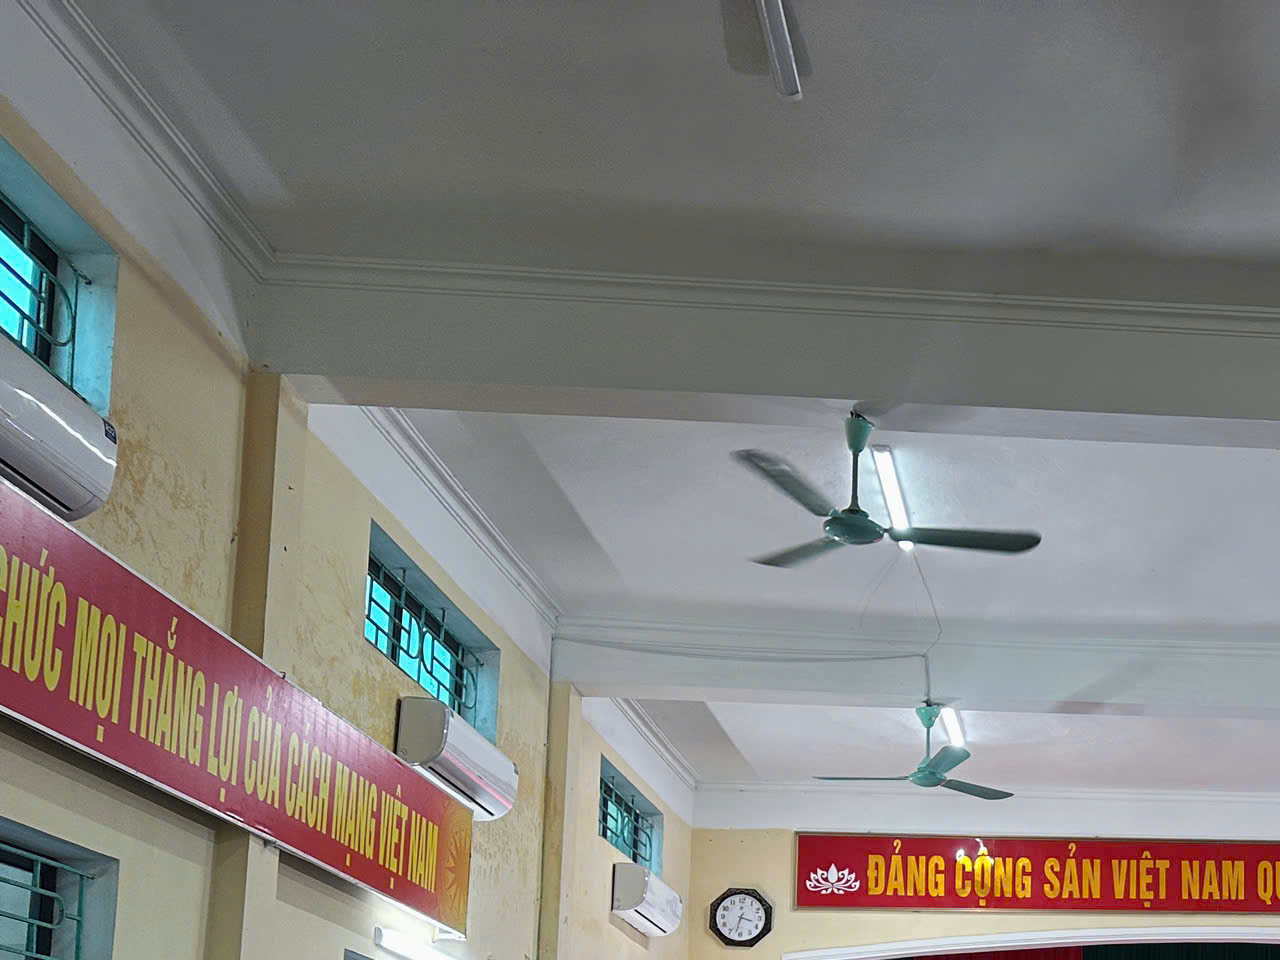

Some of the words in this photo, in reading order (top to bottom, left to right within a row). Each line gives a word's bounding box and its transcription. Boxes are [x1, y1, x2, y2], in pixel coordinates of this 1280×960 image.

[69, 596, 127, 742] MỌI
[129, 616, 207, 768] THẮNG
[207, 681, 243, 802] LỢI
[244, 685, 282, 807] CỦA
[285, 719, 332, 833] CÁCH
[331, 760, 378, 867] MẠNG
[378, 784, 409, 889] VIỆT
[407, 810, 440, 893] NAM
[867, 839, 945, 897] ĐẢNG
[955, 847, 1032, 906] CỘNG
[1043, 842, 1101, 899] SẢN
[1111, 850, 1170, 908] VIỆT
[1181, 860, 1245, 901] NAM
